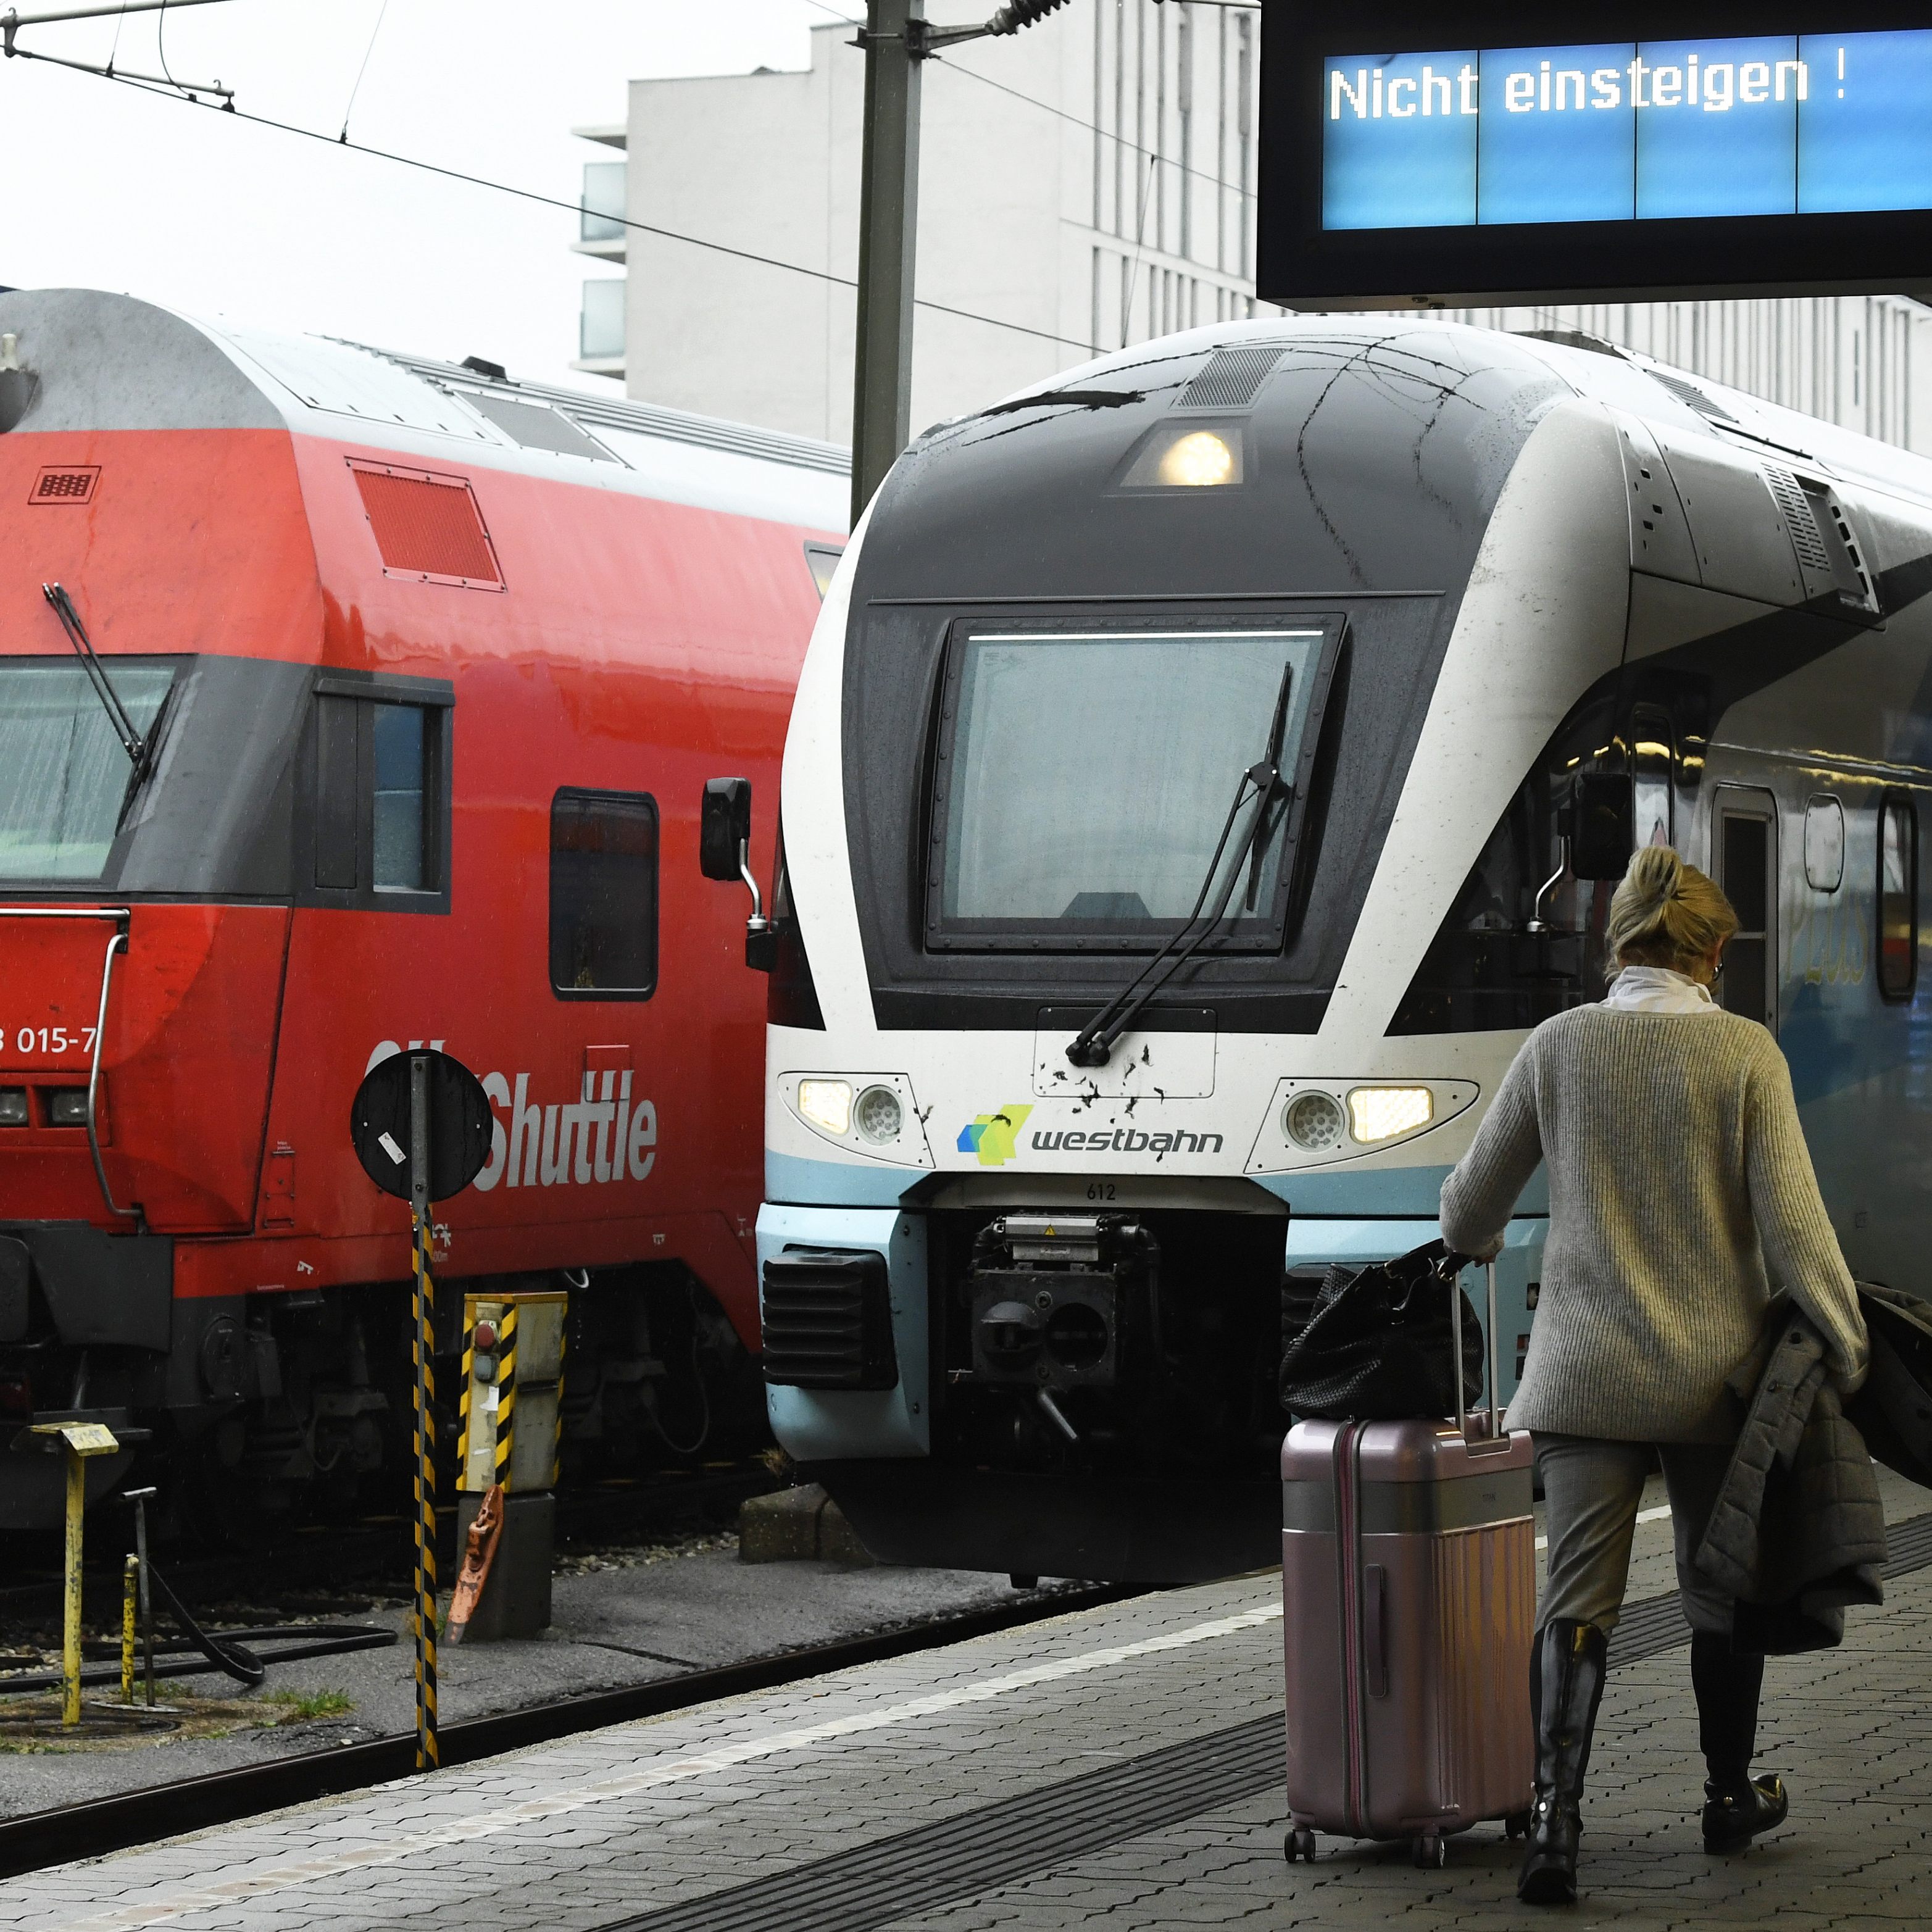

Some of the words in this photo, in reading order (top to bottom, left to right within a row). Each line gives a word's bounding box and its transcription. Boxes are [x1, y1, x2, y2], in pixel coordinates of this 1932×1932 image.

[1330, 64, 1479, 120] Nicht
[1505, 54, 1809, 112] einsteigen
[1837, 47, 1845, 99] !
[17, 1027, 96, 1053] 015-7
[472, 1070, 657, 1192] Shuttle
[1031, 1128, 1224, 1154] westbahn
[1087, 1183, 1115, 1201] 612
